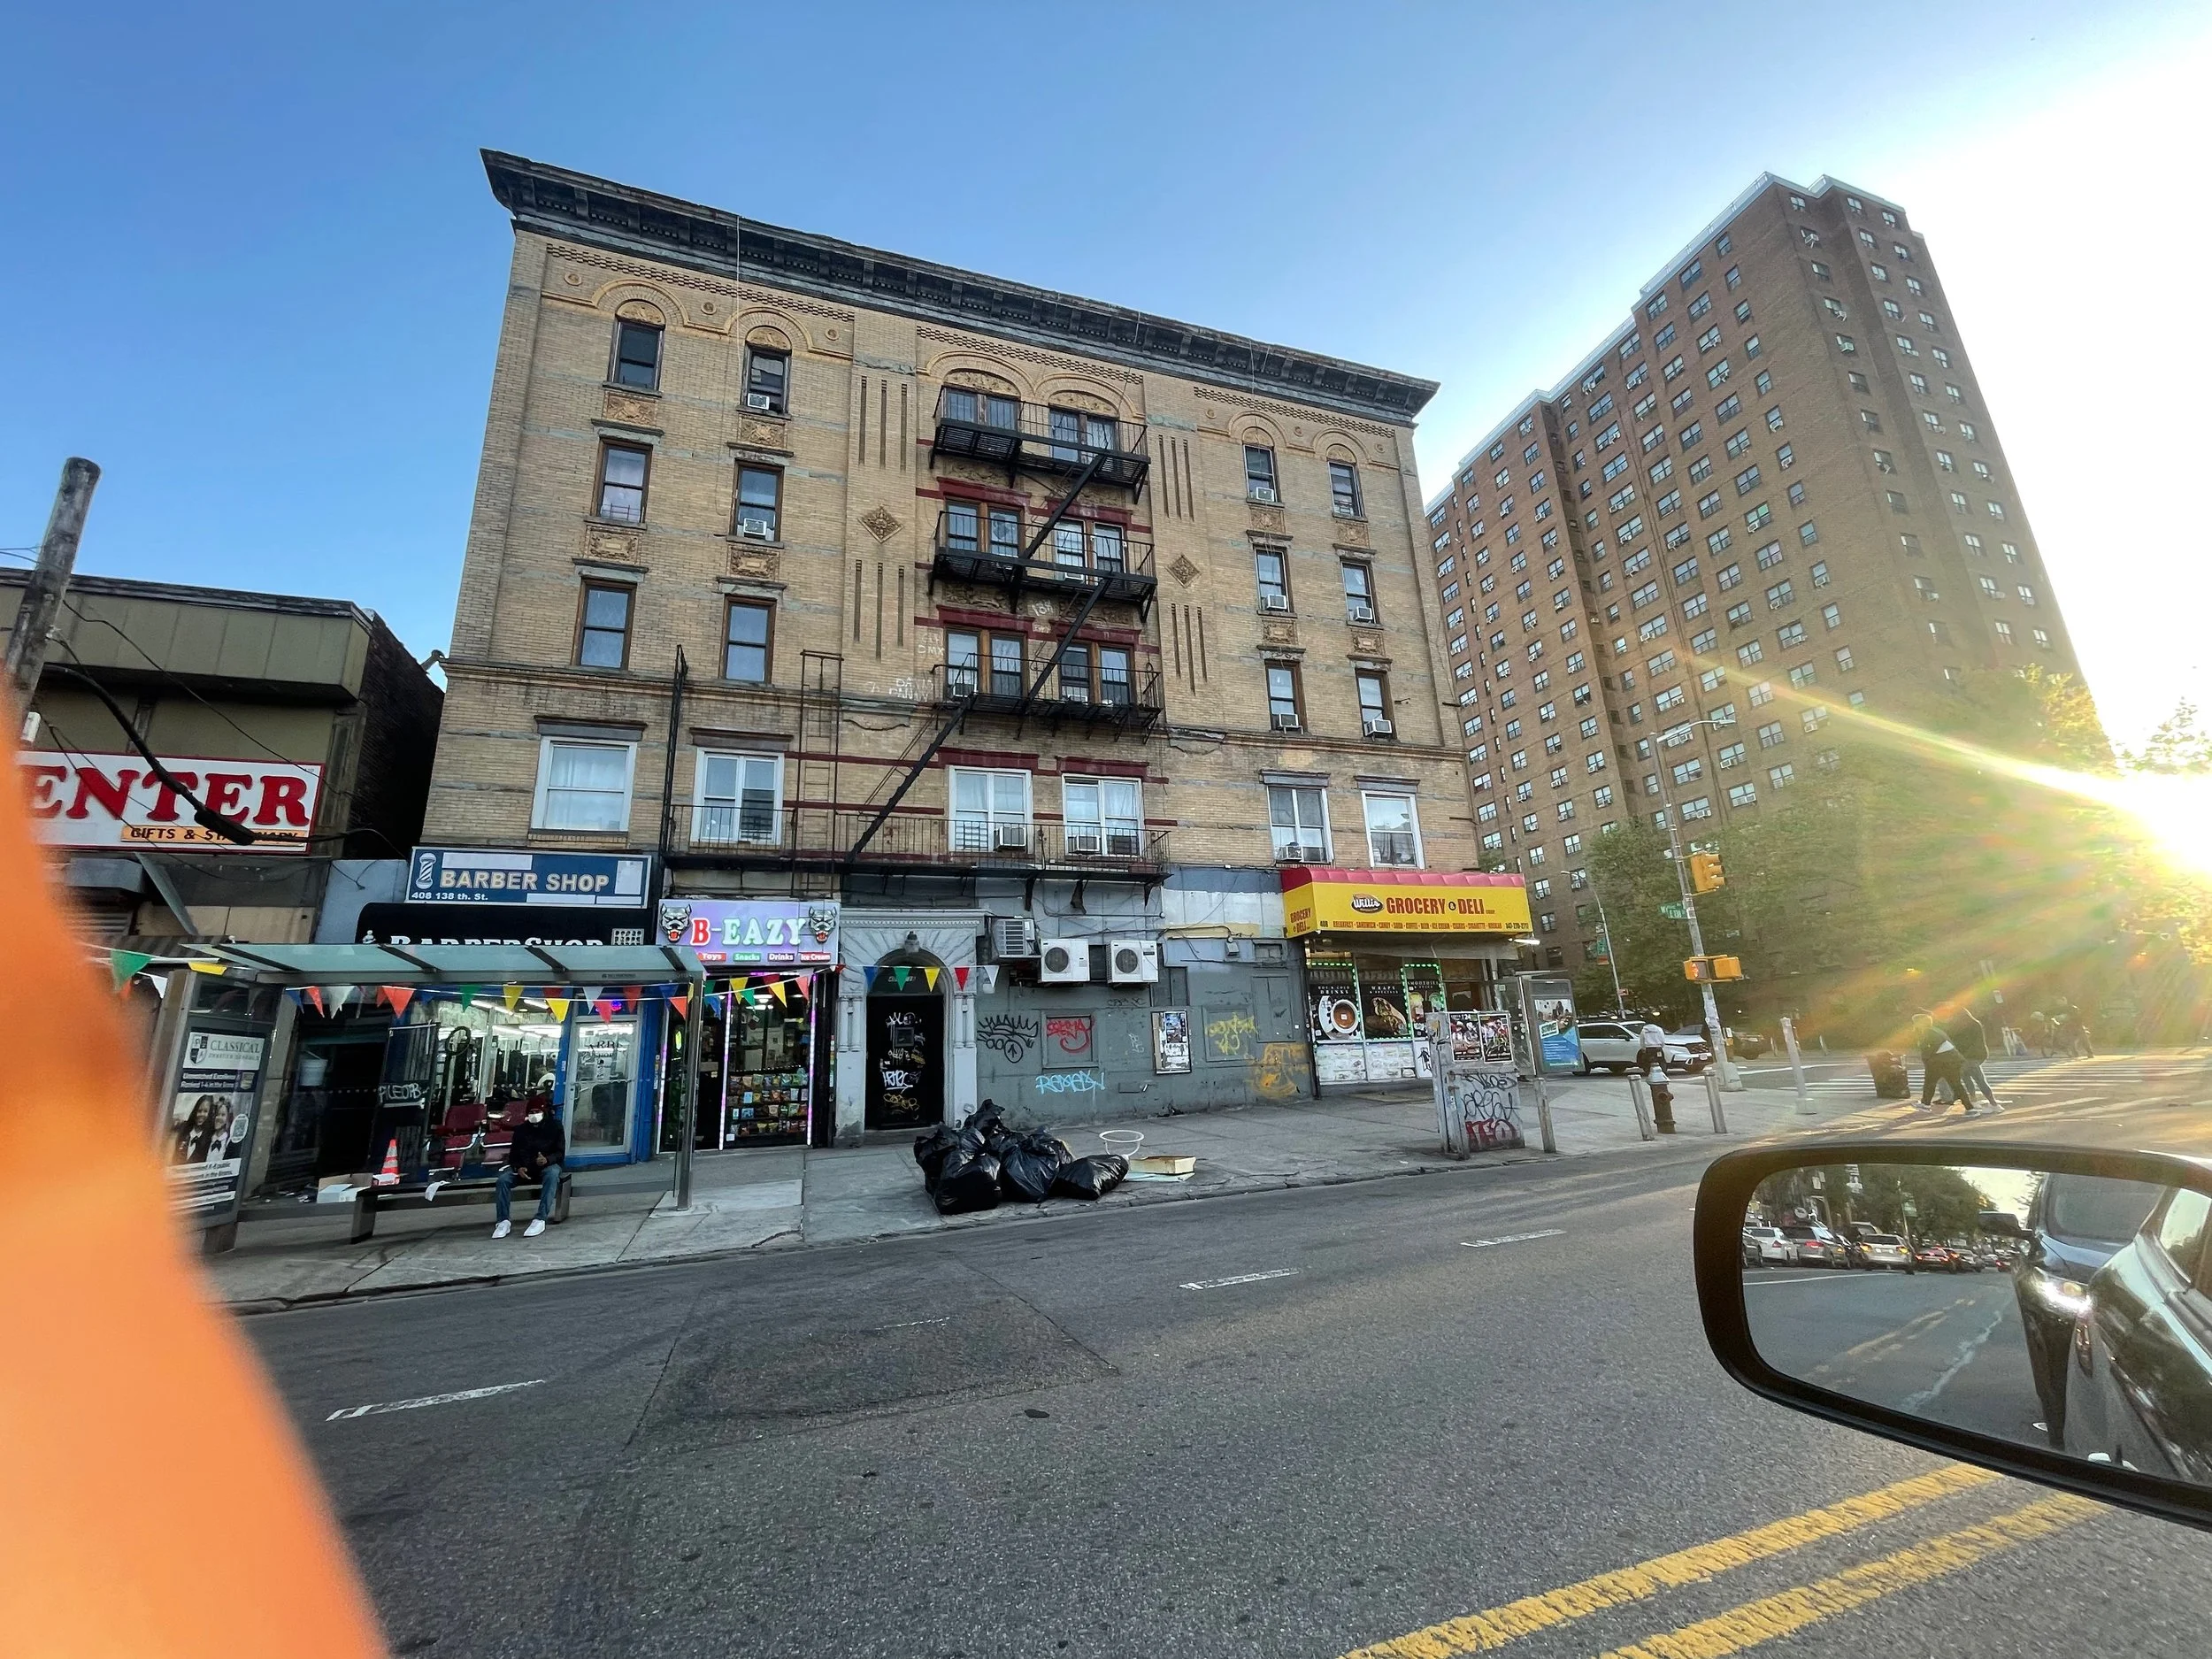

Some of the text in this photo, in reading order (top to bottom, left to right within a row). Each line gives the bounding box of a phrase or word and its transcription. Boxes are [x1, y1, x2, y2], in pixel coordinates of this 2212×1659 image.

[130, 827, 176, 840] GIFTS
[184, 829, 195, 840] &
[439, 869, 610, 892] BARBER SHOP
[411, 891, 432, 900] 408
[457, 892, 472, 901] th.
[1353, 897, 1380, 909] Willis
[1386, 897, 1446, 915] GROCERY
[1457, 898, 1485, 915] DELI
[1290, 907, 1311, 924] GROCERY
[690, 917, 807, 946] B-EAZY
[769, 952, 794, 961] Drinks
[210, 1040, 260, 1054] CLASSICAL
